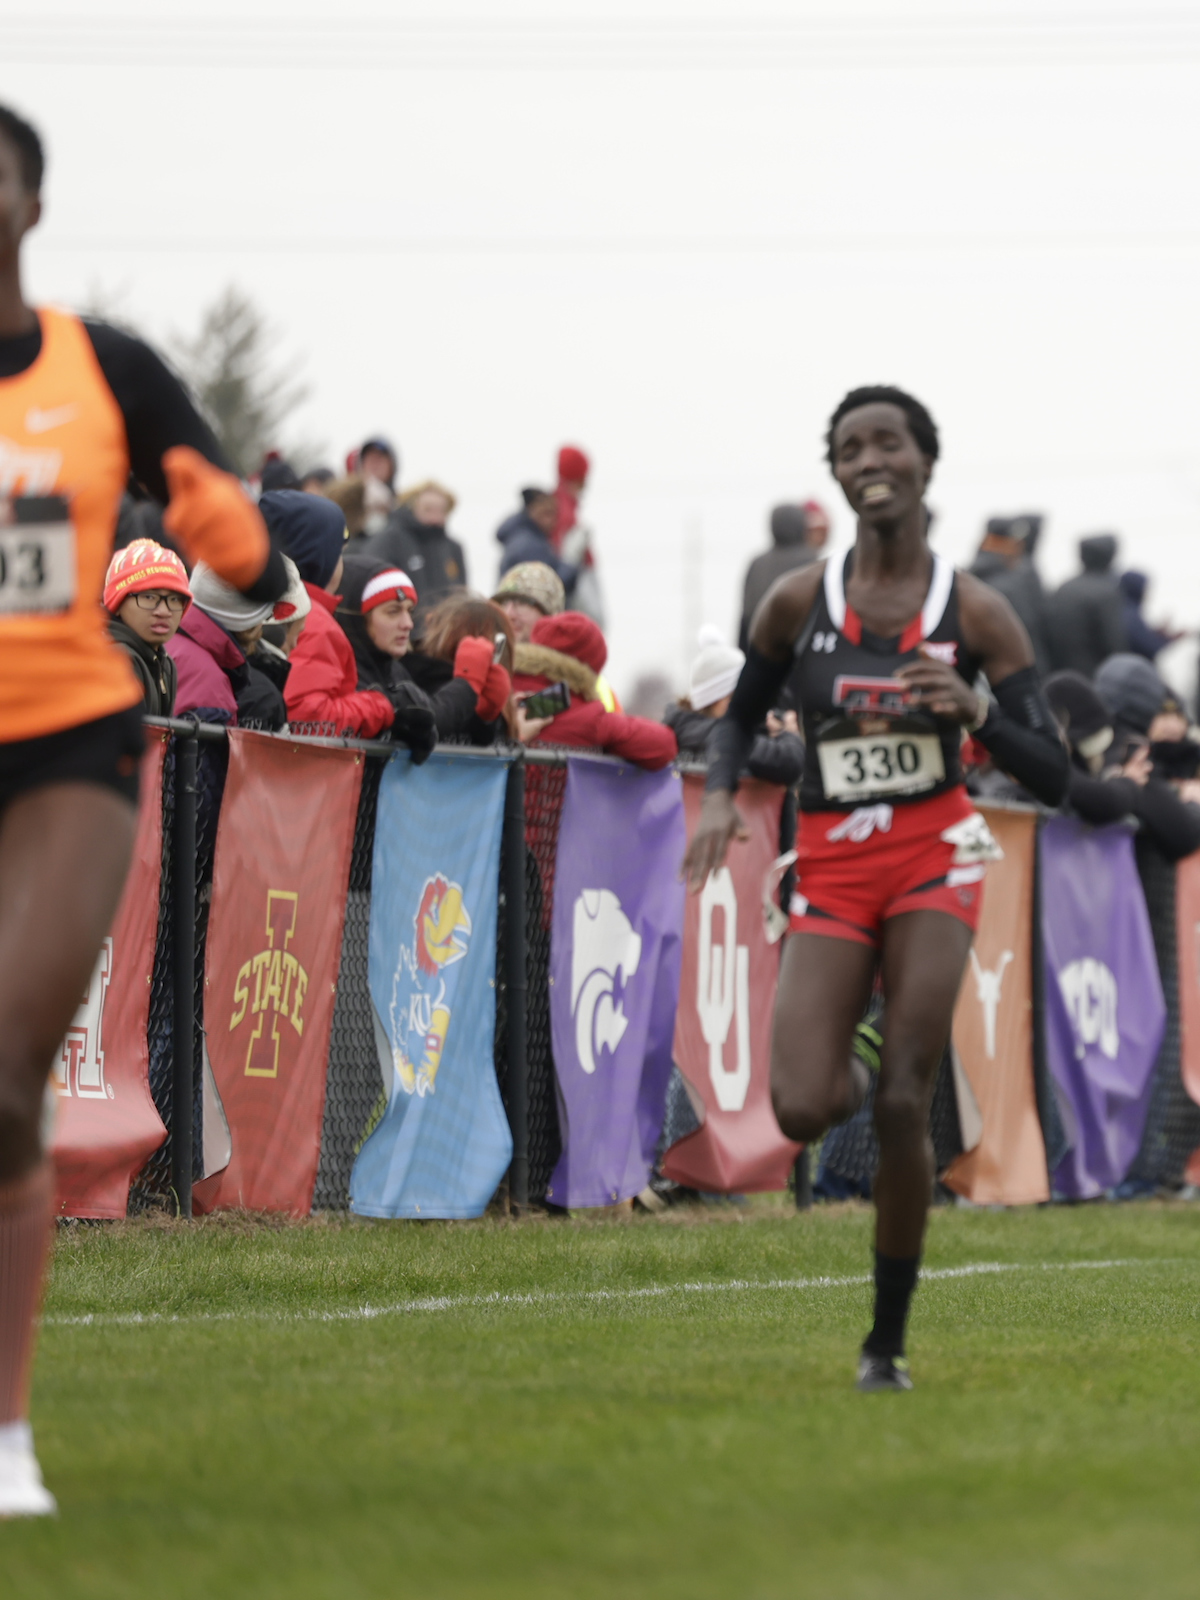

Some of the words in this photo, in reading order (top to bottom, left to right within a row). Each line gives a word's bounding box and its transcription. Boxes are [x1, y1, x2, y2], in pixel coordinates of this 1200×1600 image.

[0, 545, 44, 590] 3
[127, 570, 147, 584] CROSS
[842, 741, 920, 785] 330
[229, 950, 309, 1037] STATE
[409, 993, 432, 1037] KU
